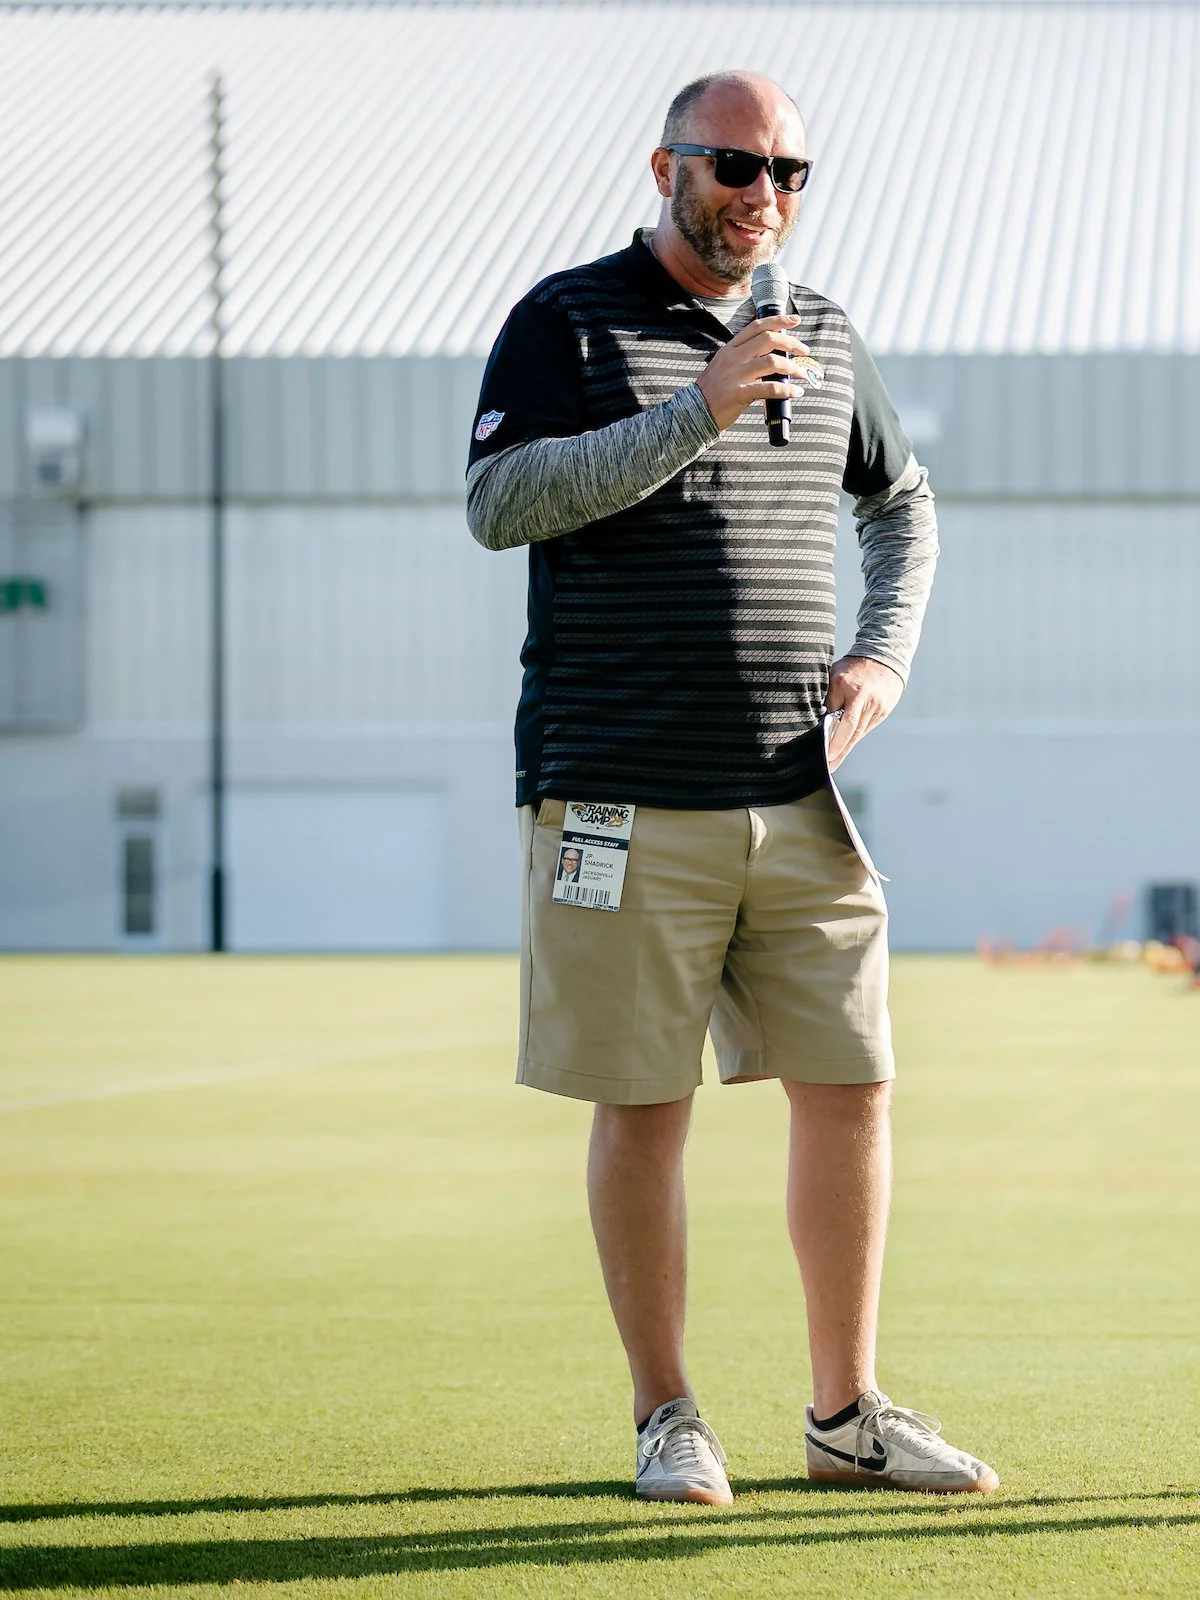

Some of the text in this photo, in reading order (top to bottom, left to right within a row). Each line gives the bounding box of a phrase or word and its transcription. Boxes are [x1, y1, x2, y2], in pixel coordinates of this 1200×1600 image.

[479, 422, 497, 437] NFL
[583, 803, 630, 818] TRAINING
[580, 813, 611, 825] CAMP
[584, 838, 604, 846] ACCESS
[584, 860, 614, 869] SHADRICK
[583, 870, 614, 878] JACKSONVILLE
